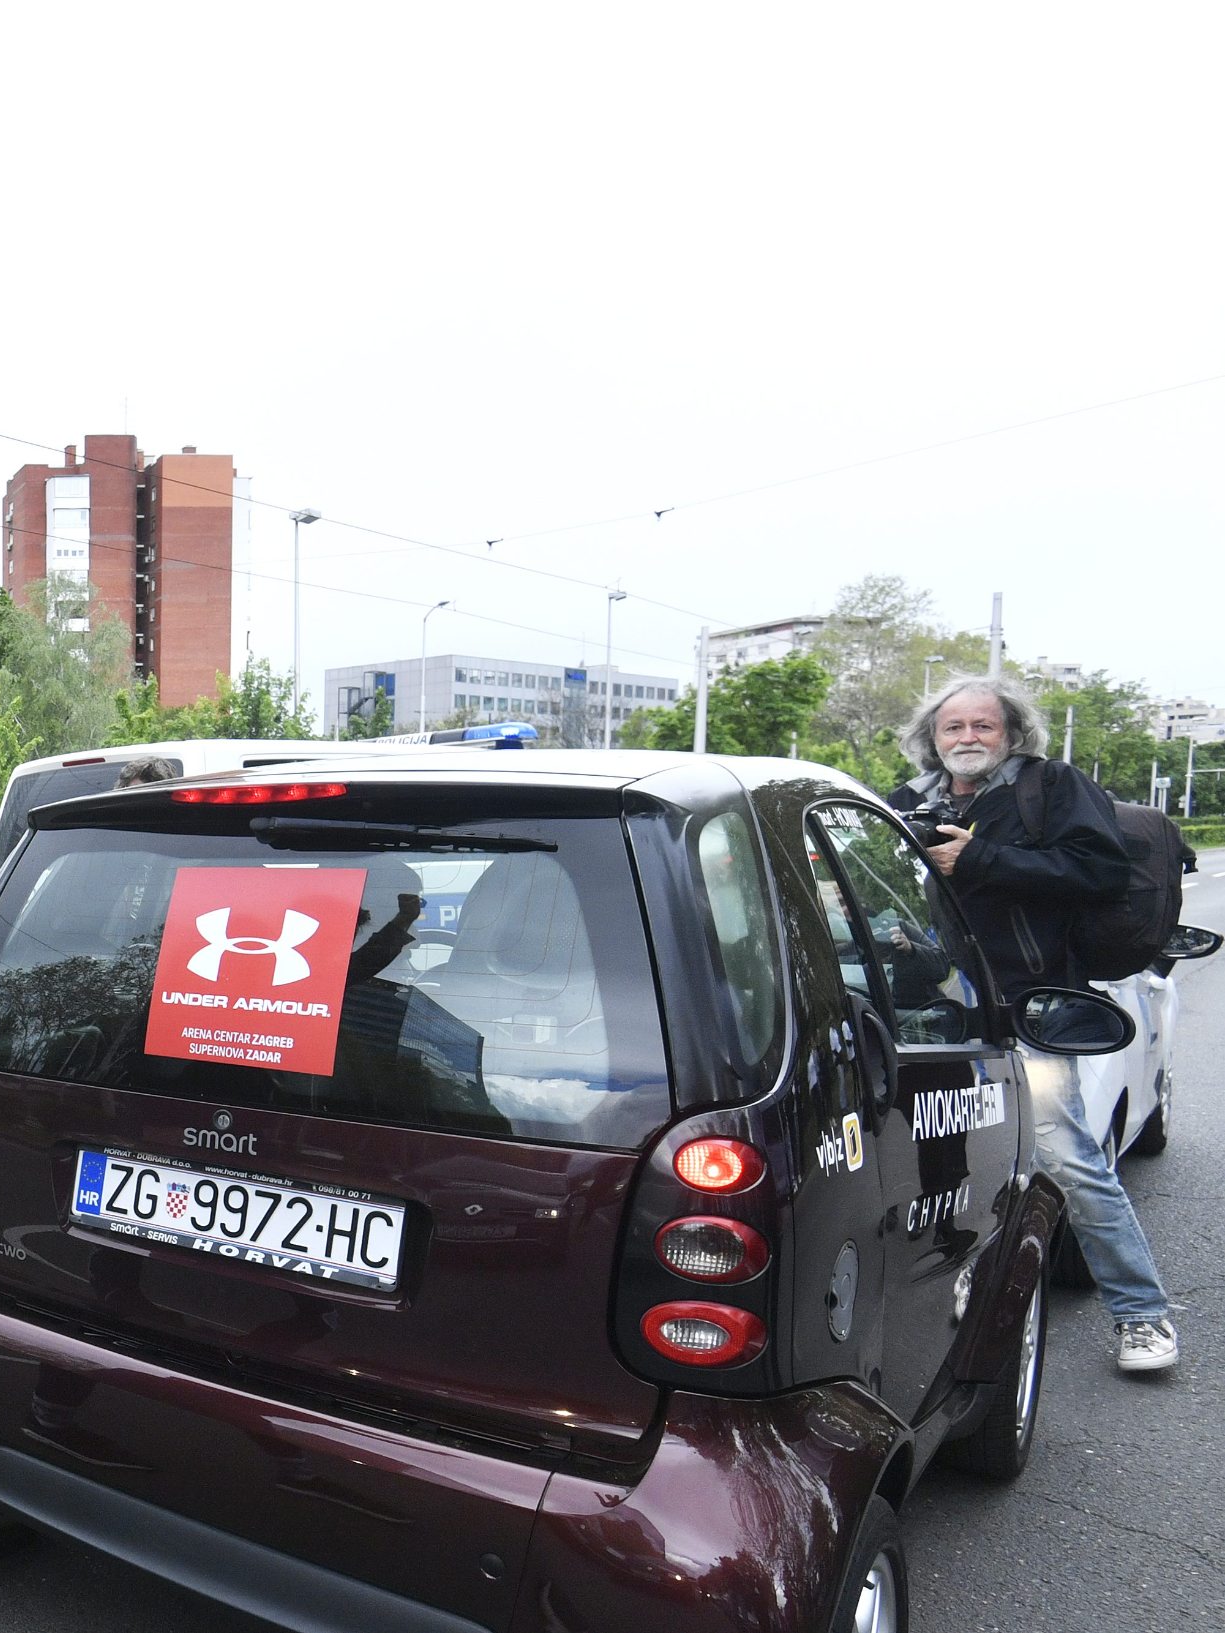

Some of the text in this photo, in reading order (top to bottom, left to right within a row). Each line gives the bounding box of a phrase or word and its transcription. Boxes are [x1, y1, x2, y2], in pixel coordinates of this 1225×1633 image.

[162, 991, 229, 1009] UNDER
[181, 1027, 294, 1049] ARENA CENTAR ZAGREB
[189, 1043, 282, 1064] SUPERNOVA ZADAR
[183, 1127, 258, 1156] smart
[103, 1147, 132, 1158] HORVAT
[137, 1152, 171, 1165] DUBRAVA
[172, 1159, 192, 1169] d.o.o.
[79, 1189, 100, 1207] HR
[106, 1163, 161, 1220] ZG
[907, 1184, 970, 1232] CHYPKA
[110, 1222, 140, 1237] smart
[147, 1230, 178, 1245] SERVIS
[192, 1238, 340, 1279] HORVAT
